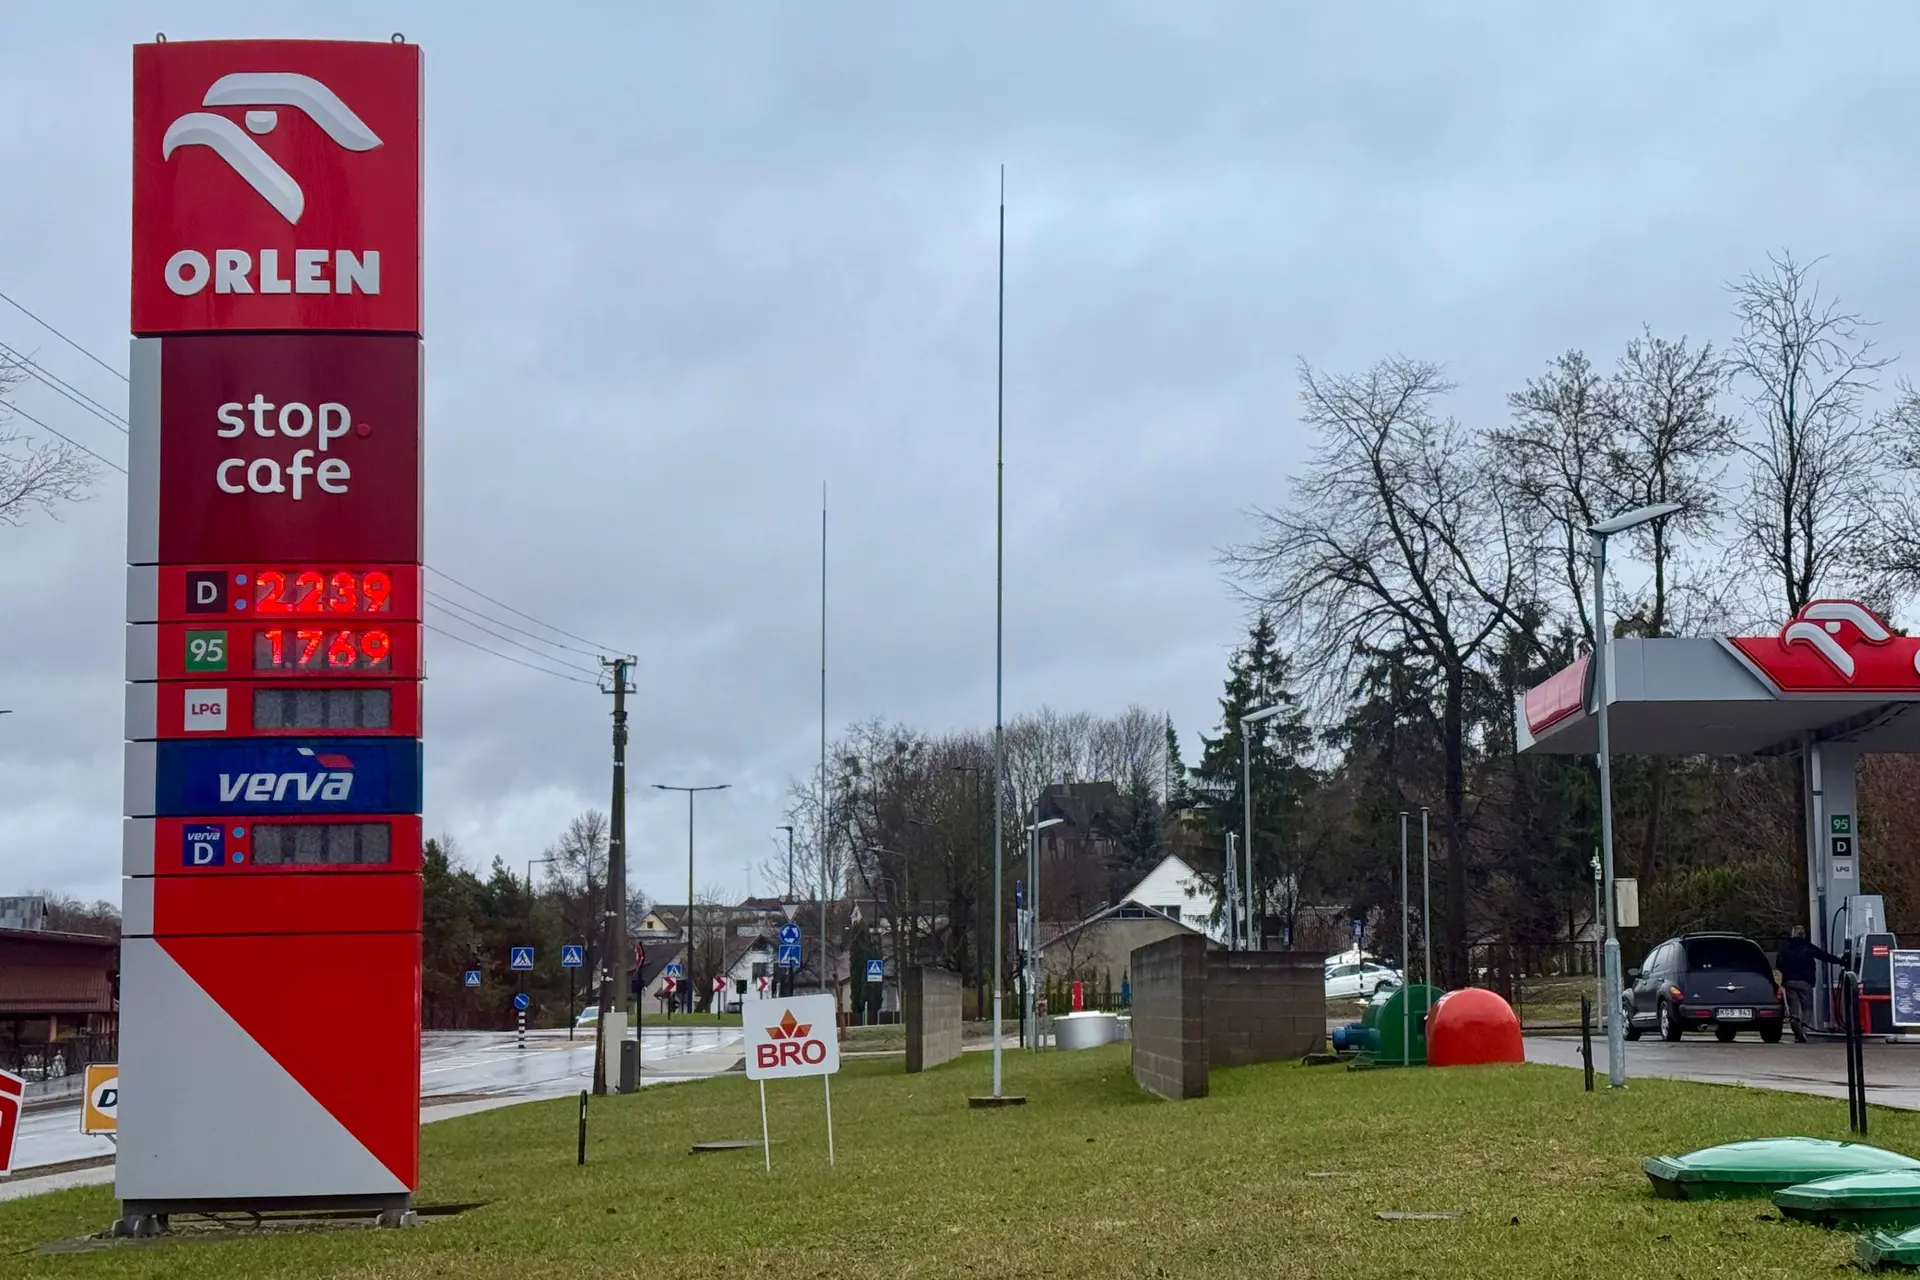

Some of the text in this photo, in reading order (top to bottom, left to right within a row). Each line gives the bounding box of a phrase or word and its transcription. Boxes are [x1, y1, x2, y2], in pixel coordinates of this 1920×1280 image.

[164, 248, 380, 296] ORLEN
[216, 449, 351, 500] cafe
[196, 580, 218, 605] D
[189, 639, 223, 662] 95
[191, 702, 222, 716] LPG
[218, 771, 354, 803] verva
[1833, 819, 1849, 830] 95
[187, 832, 220, 841] verva
[1836, 841, 1847, 852] D
[193, 842, 214, 865] D
[757, 1039, 826, 1068] BRO
